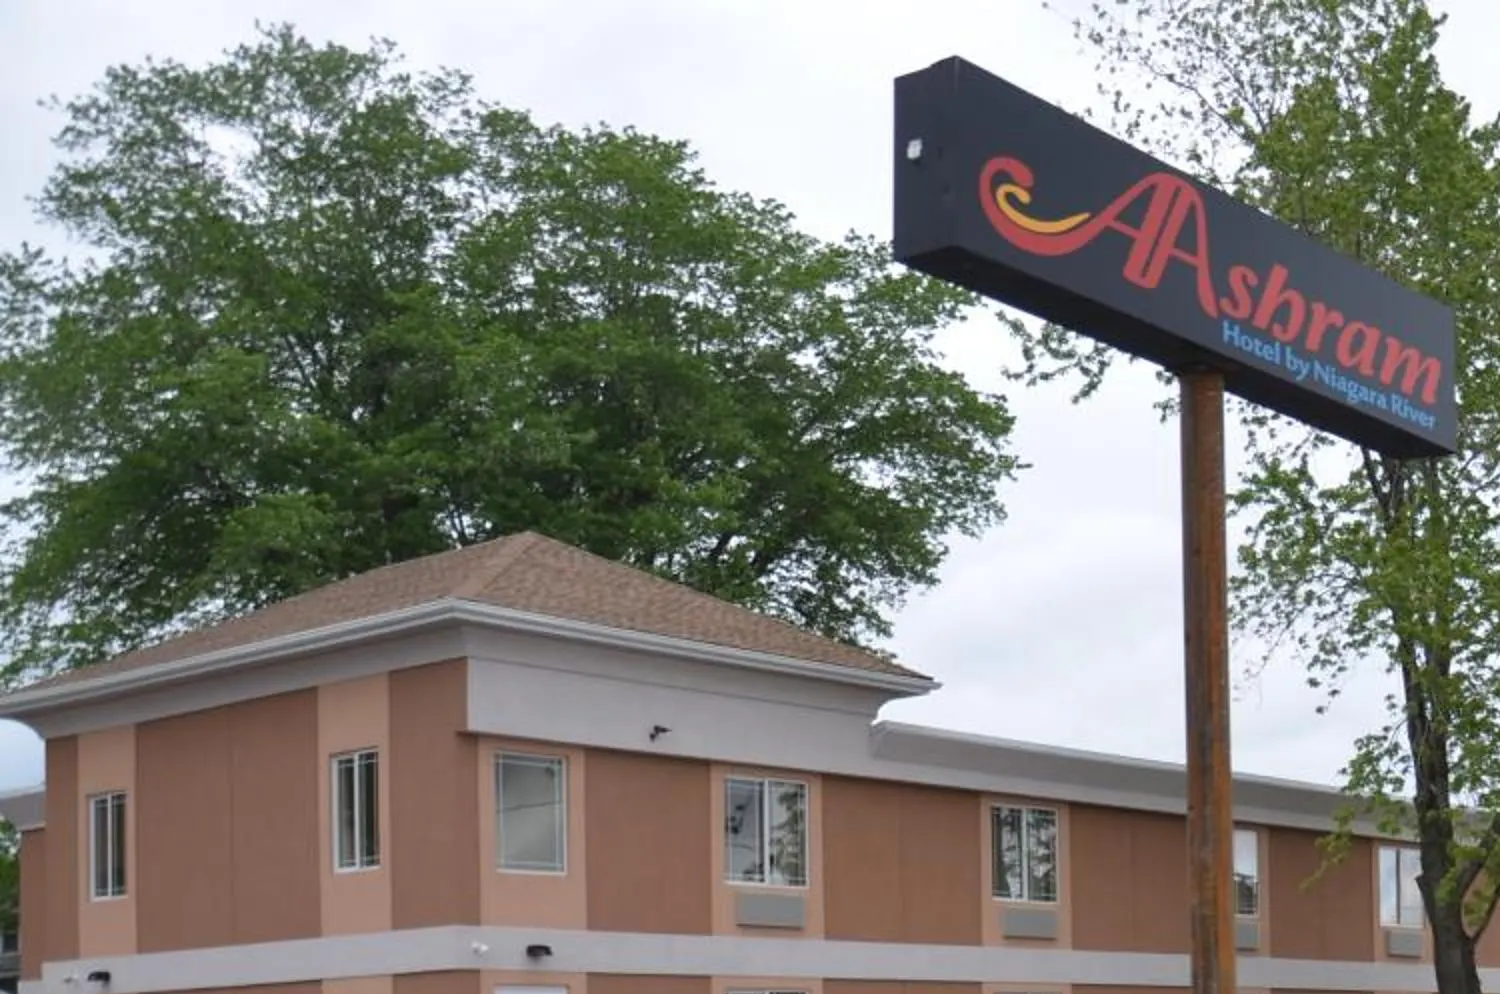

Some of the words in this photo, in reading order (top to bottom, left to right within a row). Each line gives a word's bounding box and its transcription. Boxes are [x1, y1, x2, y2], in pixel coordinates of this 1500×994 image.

[1222, 319, 1281, 364] Hotel
[1285, 345, 1312, 381] by
[1312, 359, 1387, 410] Niagara
[1391, 393, 1437, 430] River
